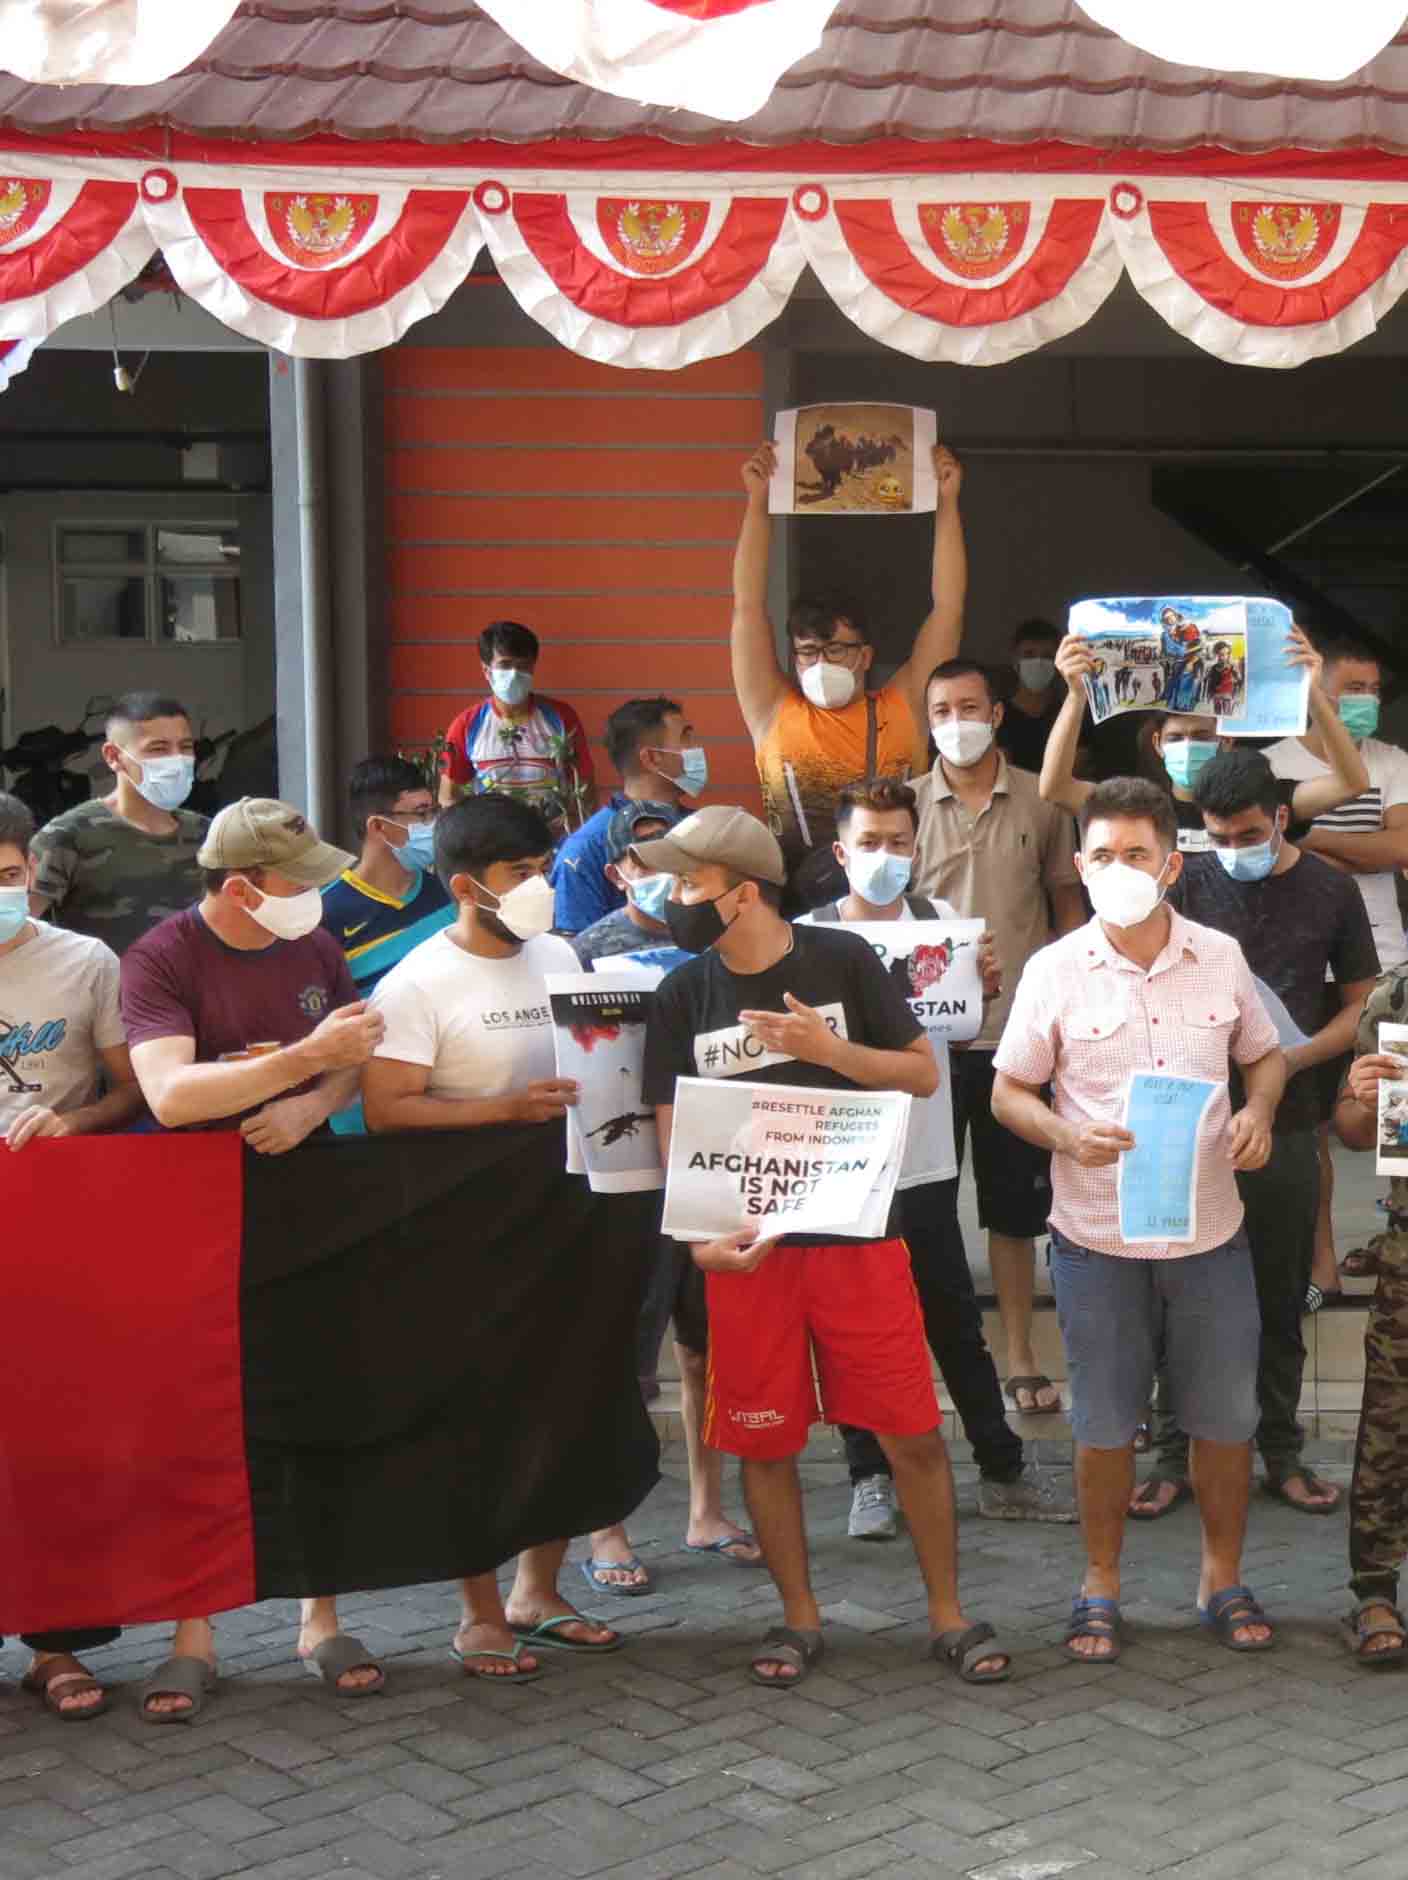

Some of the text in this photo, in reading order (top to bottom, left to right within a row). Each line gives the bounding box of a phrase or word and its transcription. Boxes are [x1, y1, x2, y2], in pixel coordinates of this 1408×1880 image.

[481, 1006, 551, 1025] LOS ANGE
[911, 999, 967, 1017] STAN
[751, 1101, 884, 1118] #RESETTLE AFGHAN
[765, 1131, 805, 1145] FROM
[688, 1152, 871, 1178] AFGHANISTAN
[739, 1176, 820, 1196] IS NOT
[746, 1198, 806, 1216] SAFE
